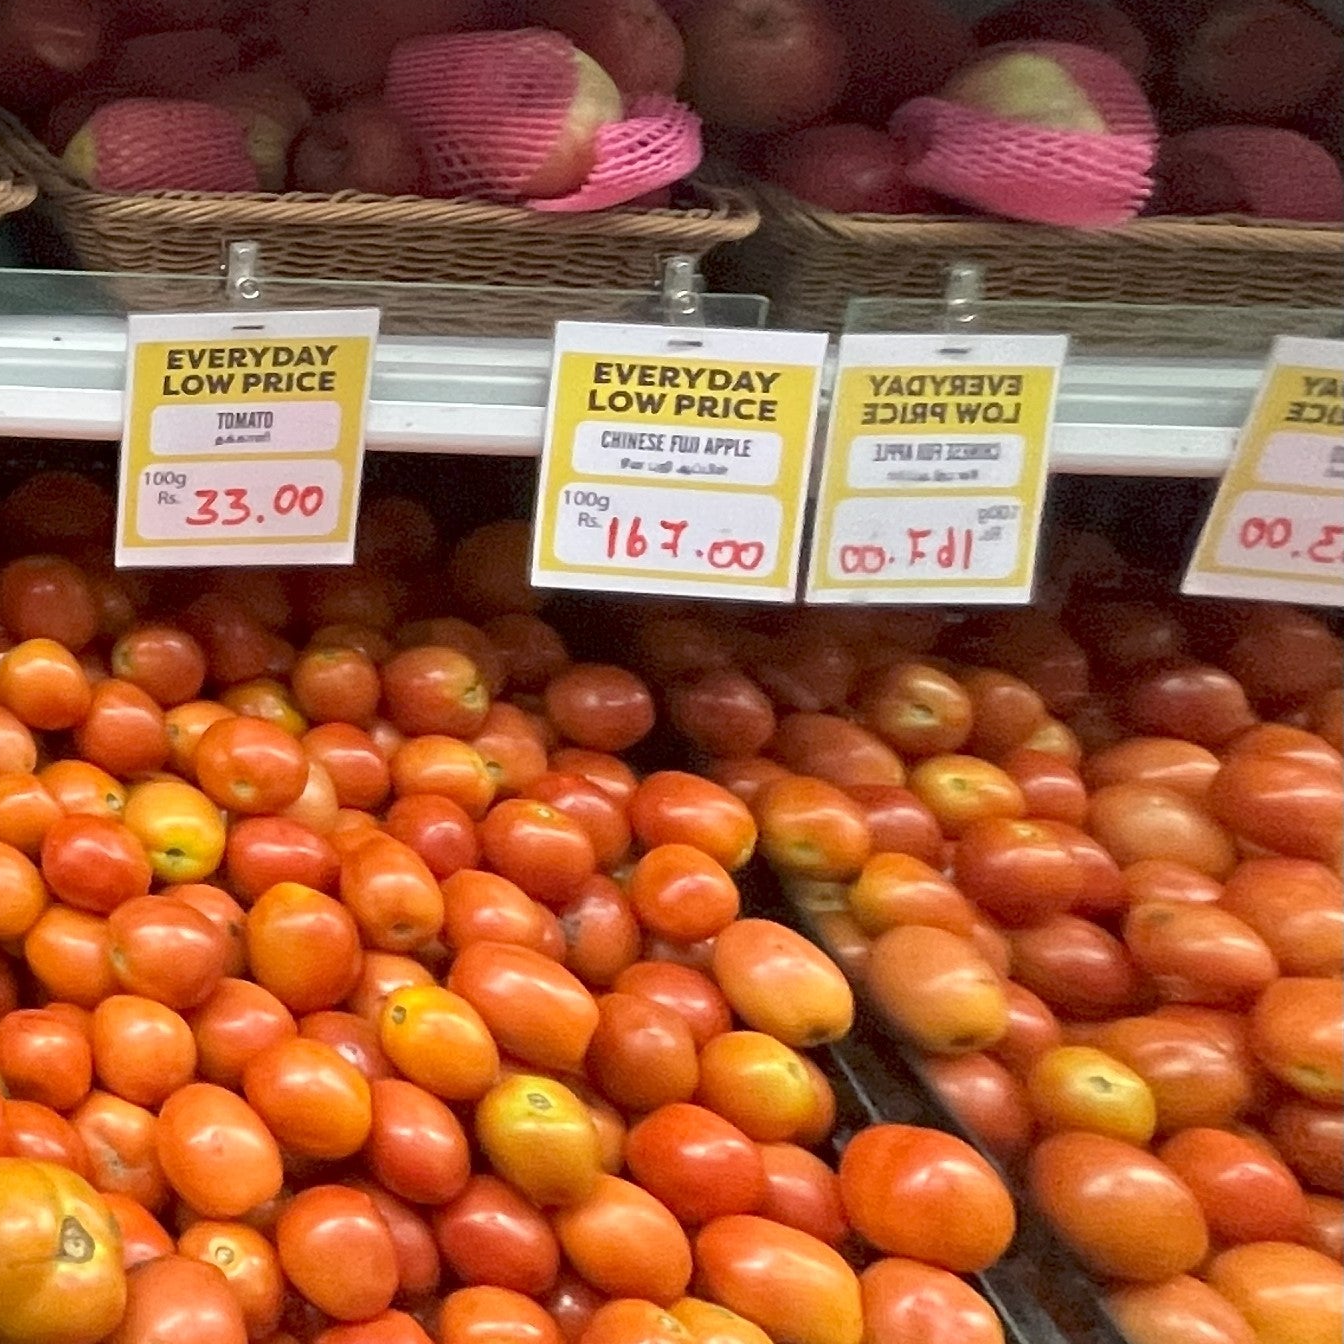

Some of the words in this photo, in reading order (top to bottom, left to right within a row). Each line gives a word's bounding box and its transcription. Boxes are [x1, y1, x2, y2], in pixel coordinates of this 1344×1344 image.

[166, 345, 339, 370] EVERYDAY
[162, 373, 234, 396] LOW
[241, 371, 336, 394] PRICE
[593, 362, 781, 394] EVERYDAY
[587, 389, 666, 415] LOW
[673, 394, 778, 422] PRICE
[217, 411, 273, 430] TOMATO
[601, 430, 664, 452] CHINESE
[670, 435, 699, 454] FUJI
[704, 438, 752, 457] APPLE
[144, 471, 186, 487] 100g
[186, 483, 324, 526] 33.00
[563, 490, 610, 511] 100g
[606, 516, 765, 570] 167.00
